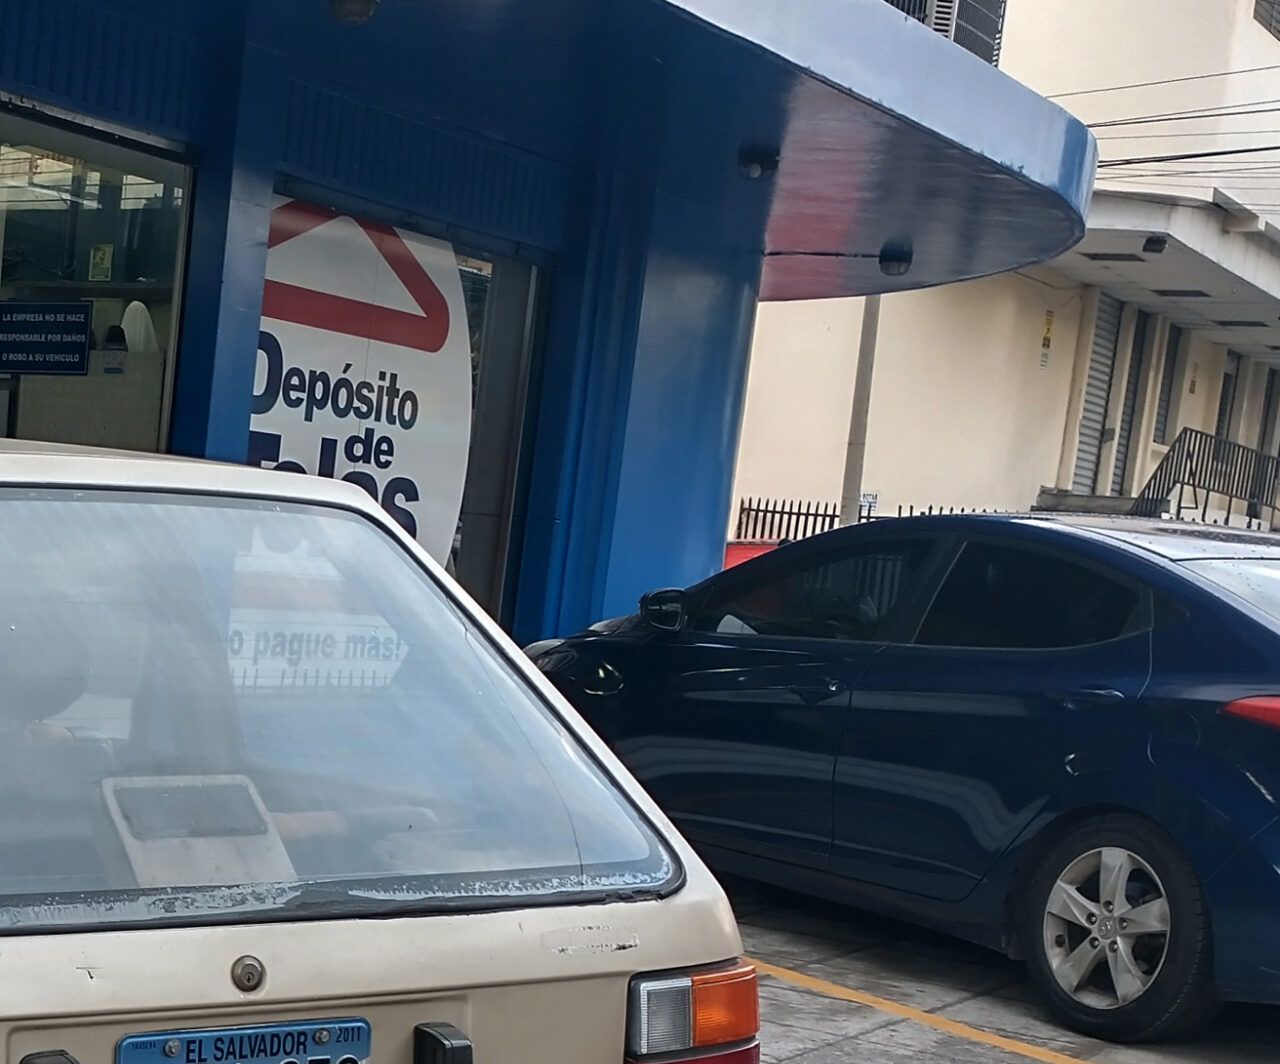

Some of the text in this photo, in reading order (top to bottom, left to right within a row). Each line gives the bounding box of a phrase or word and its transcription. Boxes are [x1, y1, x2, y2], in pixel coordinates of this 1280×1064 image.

[12, 313, 44, 321] EMPRESA
[0, 332, 86, 342] RESPONSABLE POR DAÑOS
[250, 330, 418, 430] Depósito
[344, 427, 395, 470] de
[252, 630, 337, 667] pague
[186, 1031, 308, 1063] EL SALVADOR
[335, 1027, 362, 1043] 2011
